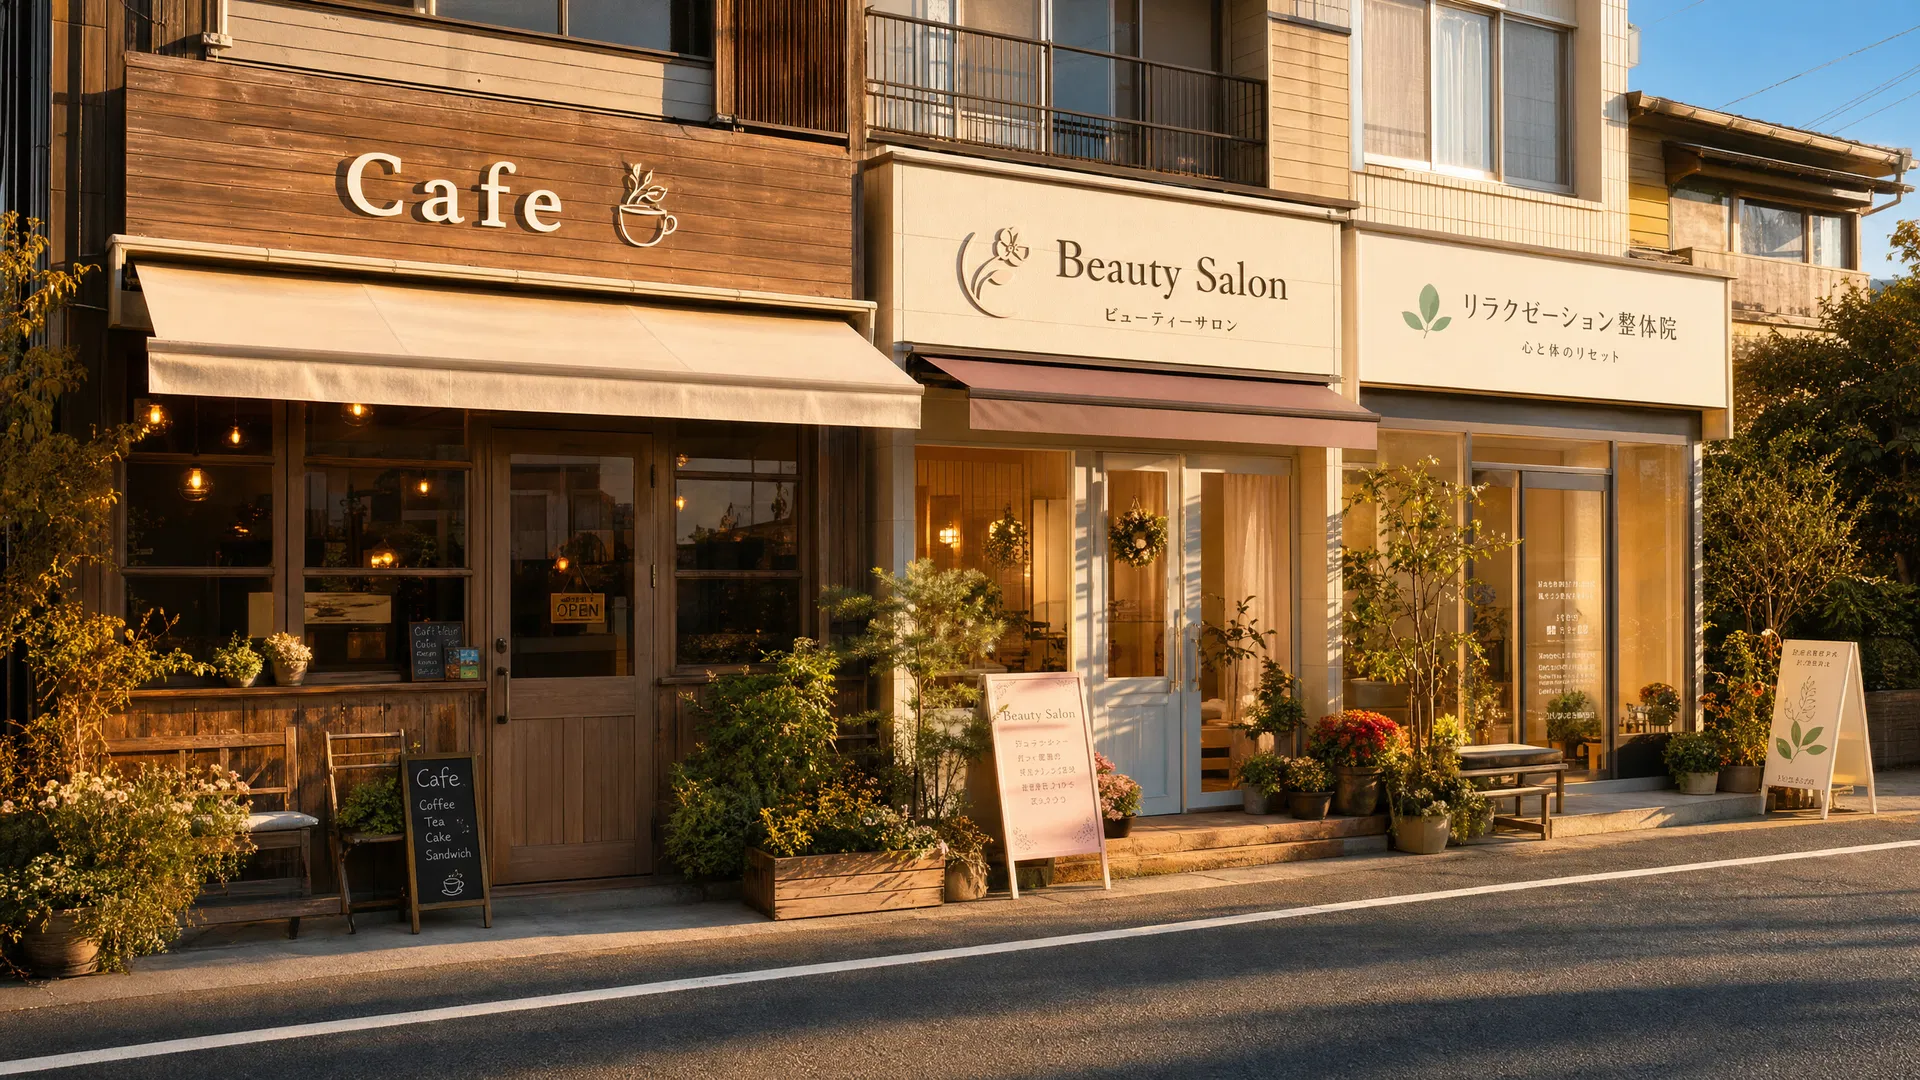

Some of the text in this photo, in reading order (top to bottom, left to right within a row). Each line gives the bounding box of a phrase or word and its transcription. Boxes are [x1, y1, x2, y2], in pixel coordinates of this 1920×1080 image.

[347, 152, 562, 233] Cafe
[1056, 239, 1289, 300] Beauty Salon
[1105, 307, 1238, 332] ビューティーサロン
[1464, 293, 1678, 341] リラクゼーション整体院
[1521, 341, 1619, 363] 心と体のリセット
[557, 603, 599, 617] OPEN
[1003, 708, 1076, 722] Beauty Salon
[416, 766, 460, 788] Cafe
[419, 797, 455, 811] Coffee
[424, 816, 445, 827] Tea
[425, 832, 452, 843] Cake
[425, 847, 472, 861] Sandwich
